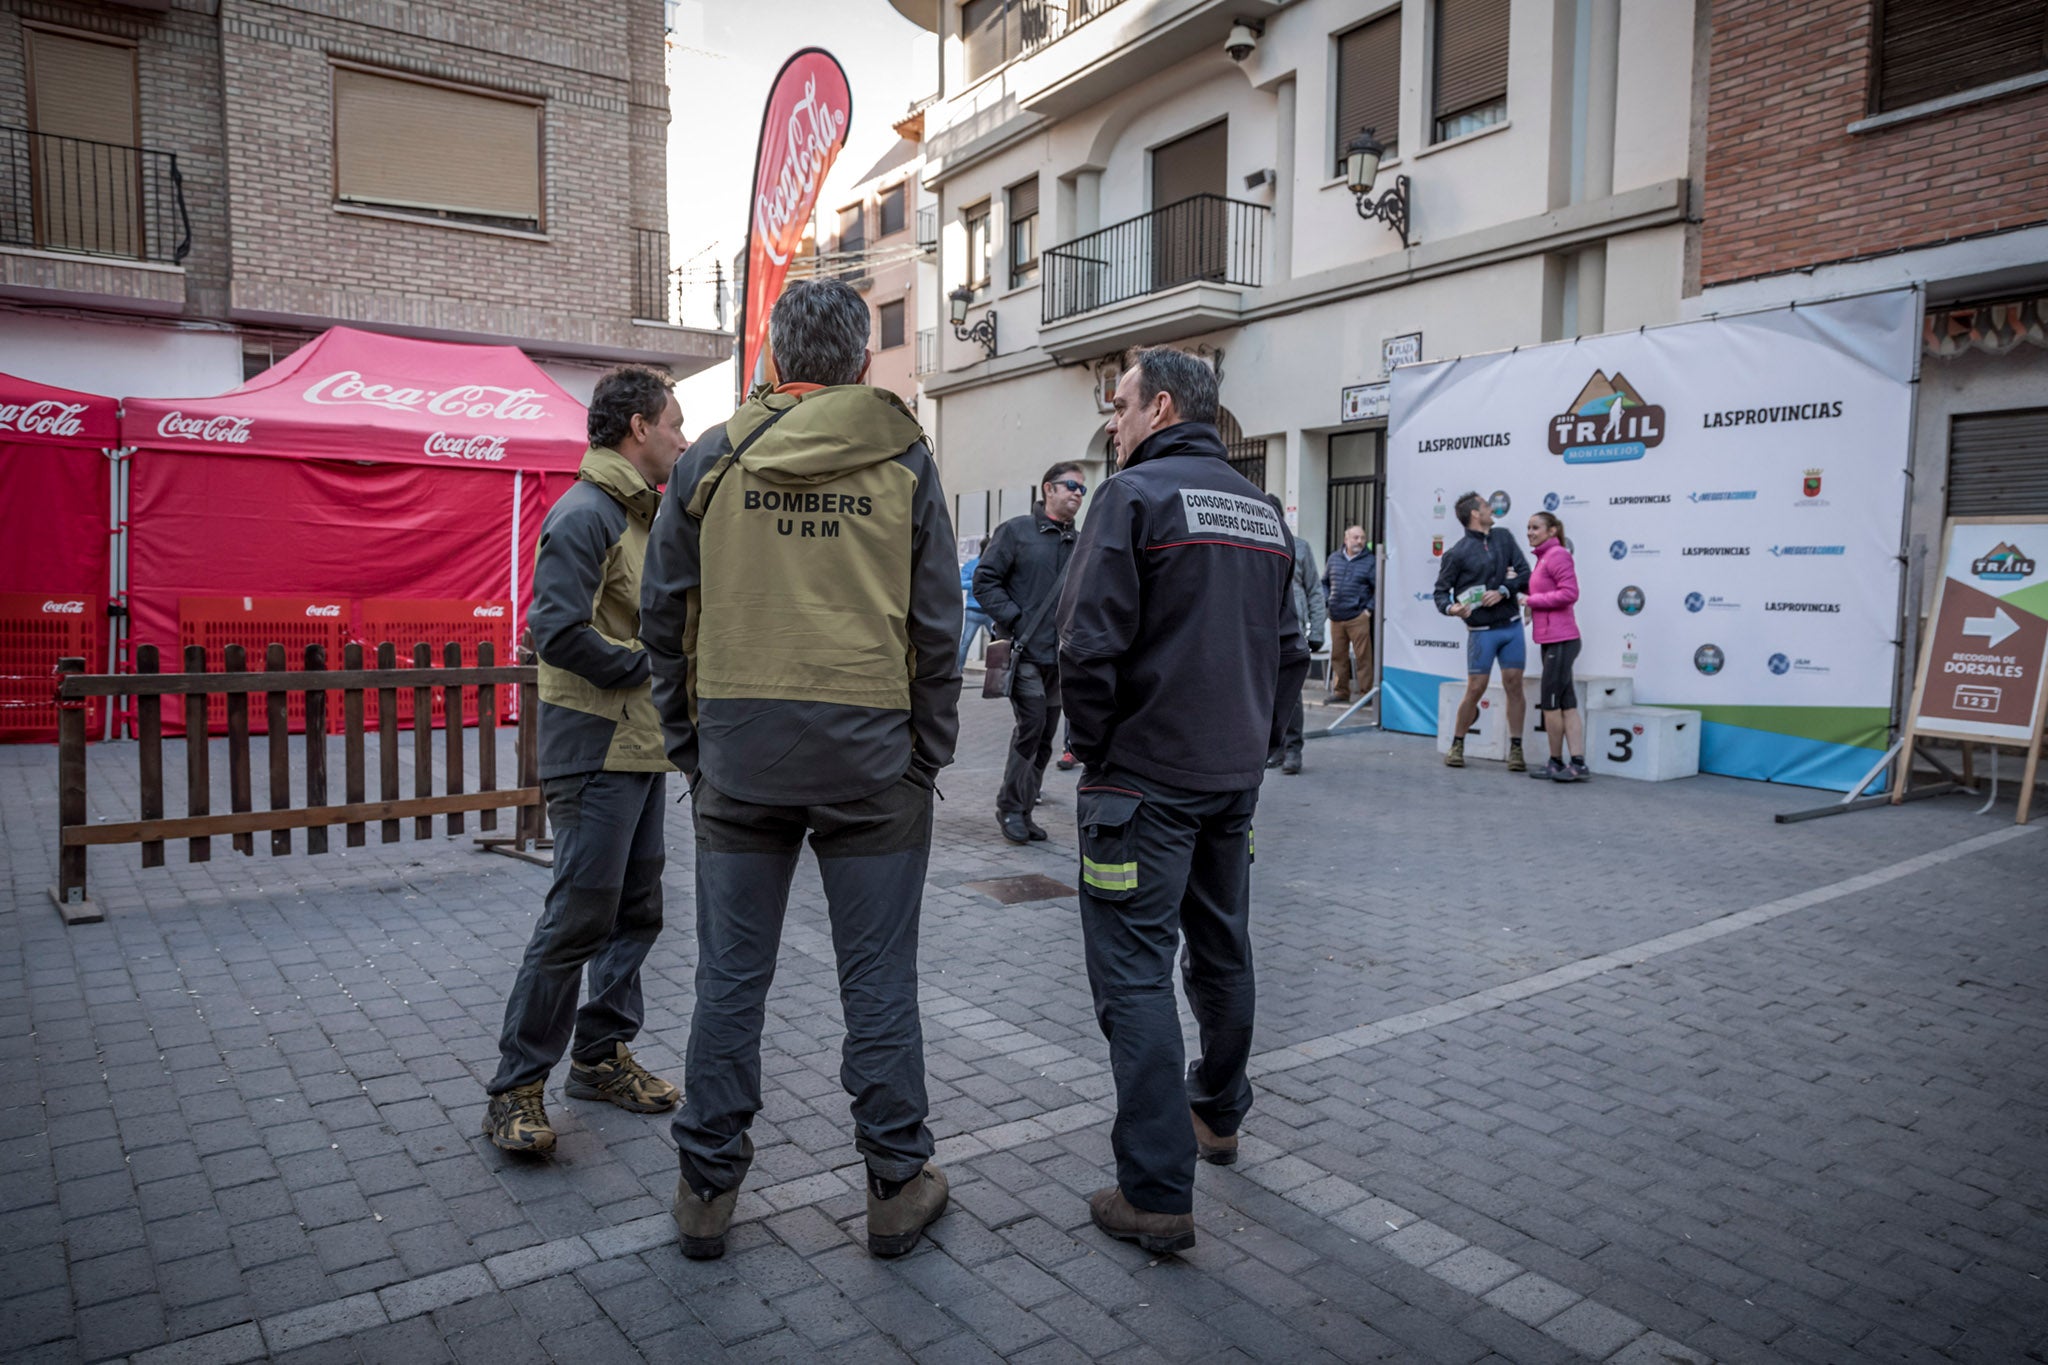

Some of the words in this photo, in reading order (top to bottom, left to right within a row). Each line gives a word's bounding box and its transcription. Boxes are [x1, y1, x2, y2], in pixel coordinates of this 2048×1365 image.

[302, 371, 550, 420] Coca-Cola
[1703, 401, 1843, 428] LASPROVINCIAS
[157, 411, 255, 443] Coca-Cola
[424, 431, 510, 462] Coca-Cola
[1418, 432, 1511, 453] LASPROVINCIAS
[1569, 446, 1639, 459] MONTANEJOS
[744, 490, 873, 516] BOMBERS
[1186, 494, 1234, 511] CONSORCI
[1235, 501, 1278, 522] PROVINCIAL
[1609, 494, 1671, 505] LASPROVINCIAS
[1197, 512, 1240, 530] BOMBERS
[1682, 546, 1750, 556] LASPROVINCIAS
[1764, 602, 1840, 613] LASPROVINCIAS
[1414, 639, 1460, 649] LASPROVINCIAS
[1952, 653, 2000, 663] RECOGIDA
[2002, 655, 2016, 664] DE
[1944, 661, 2023, 678] DORSALES
[1607, 728, 1633, 763] 3
